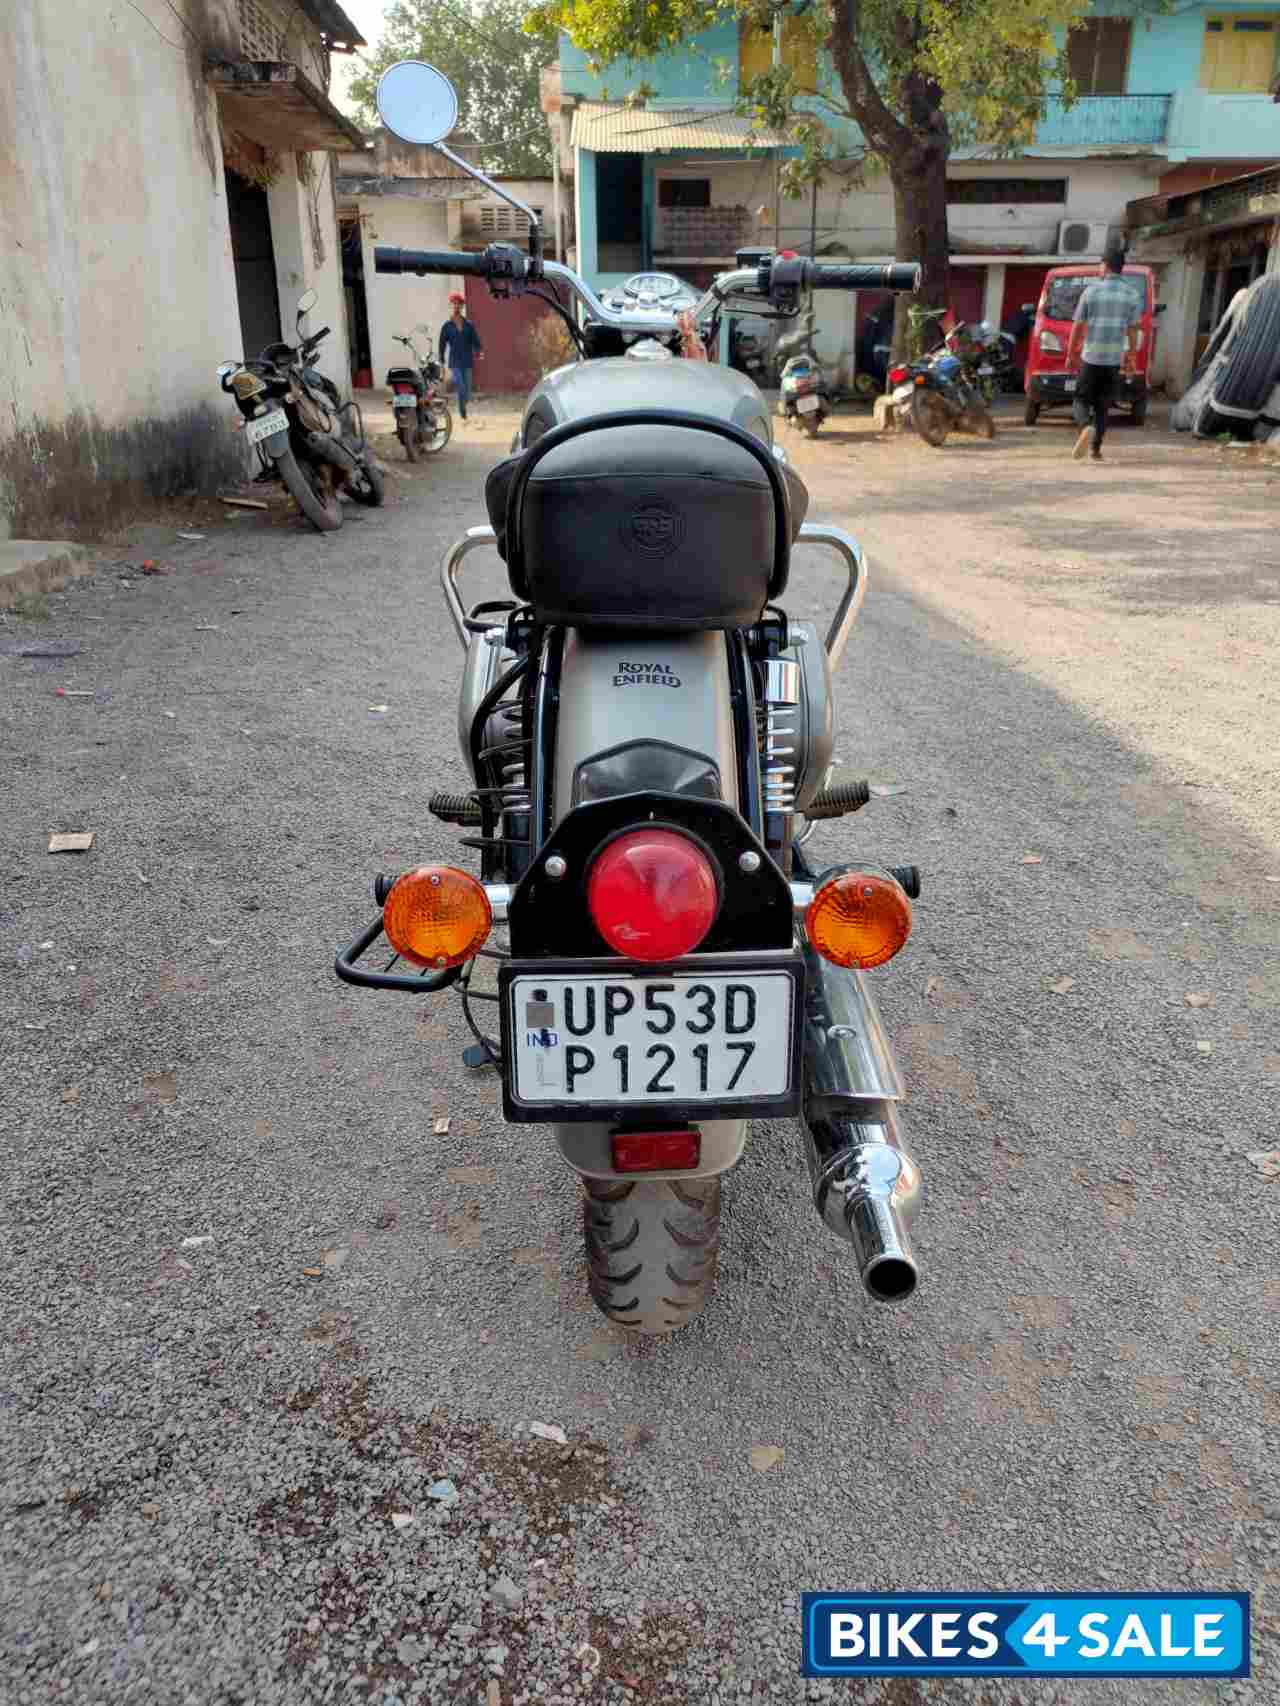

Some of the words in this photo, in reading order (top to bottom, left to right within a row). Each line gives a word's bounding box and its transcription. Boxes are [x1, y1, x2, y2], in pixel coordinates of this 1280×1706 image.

[613, 674, 681, 688] ENFIELD
[618, 662, 674, 674] ROYAL
[564, 984, 757, 1036] UP53D
[565, 1041, 756, 1094] P1217
